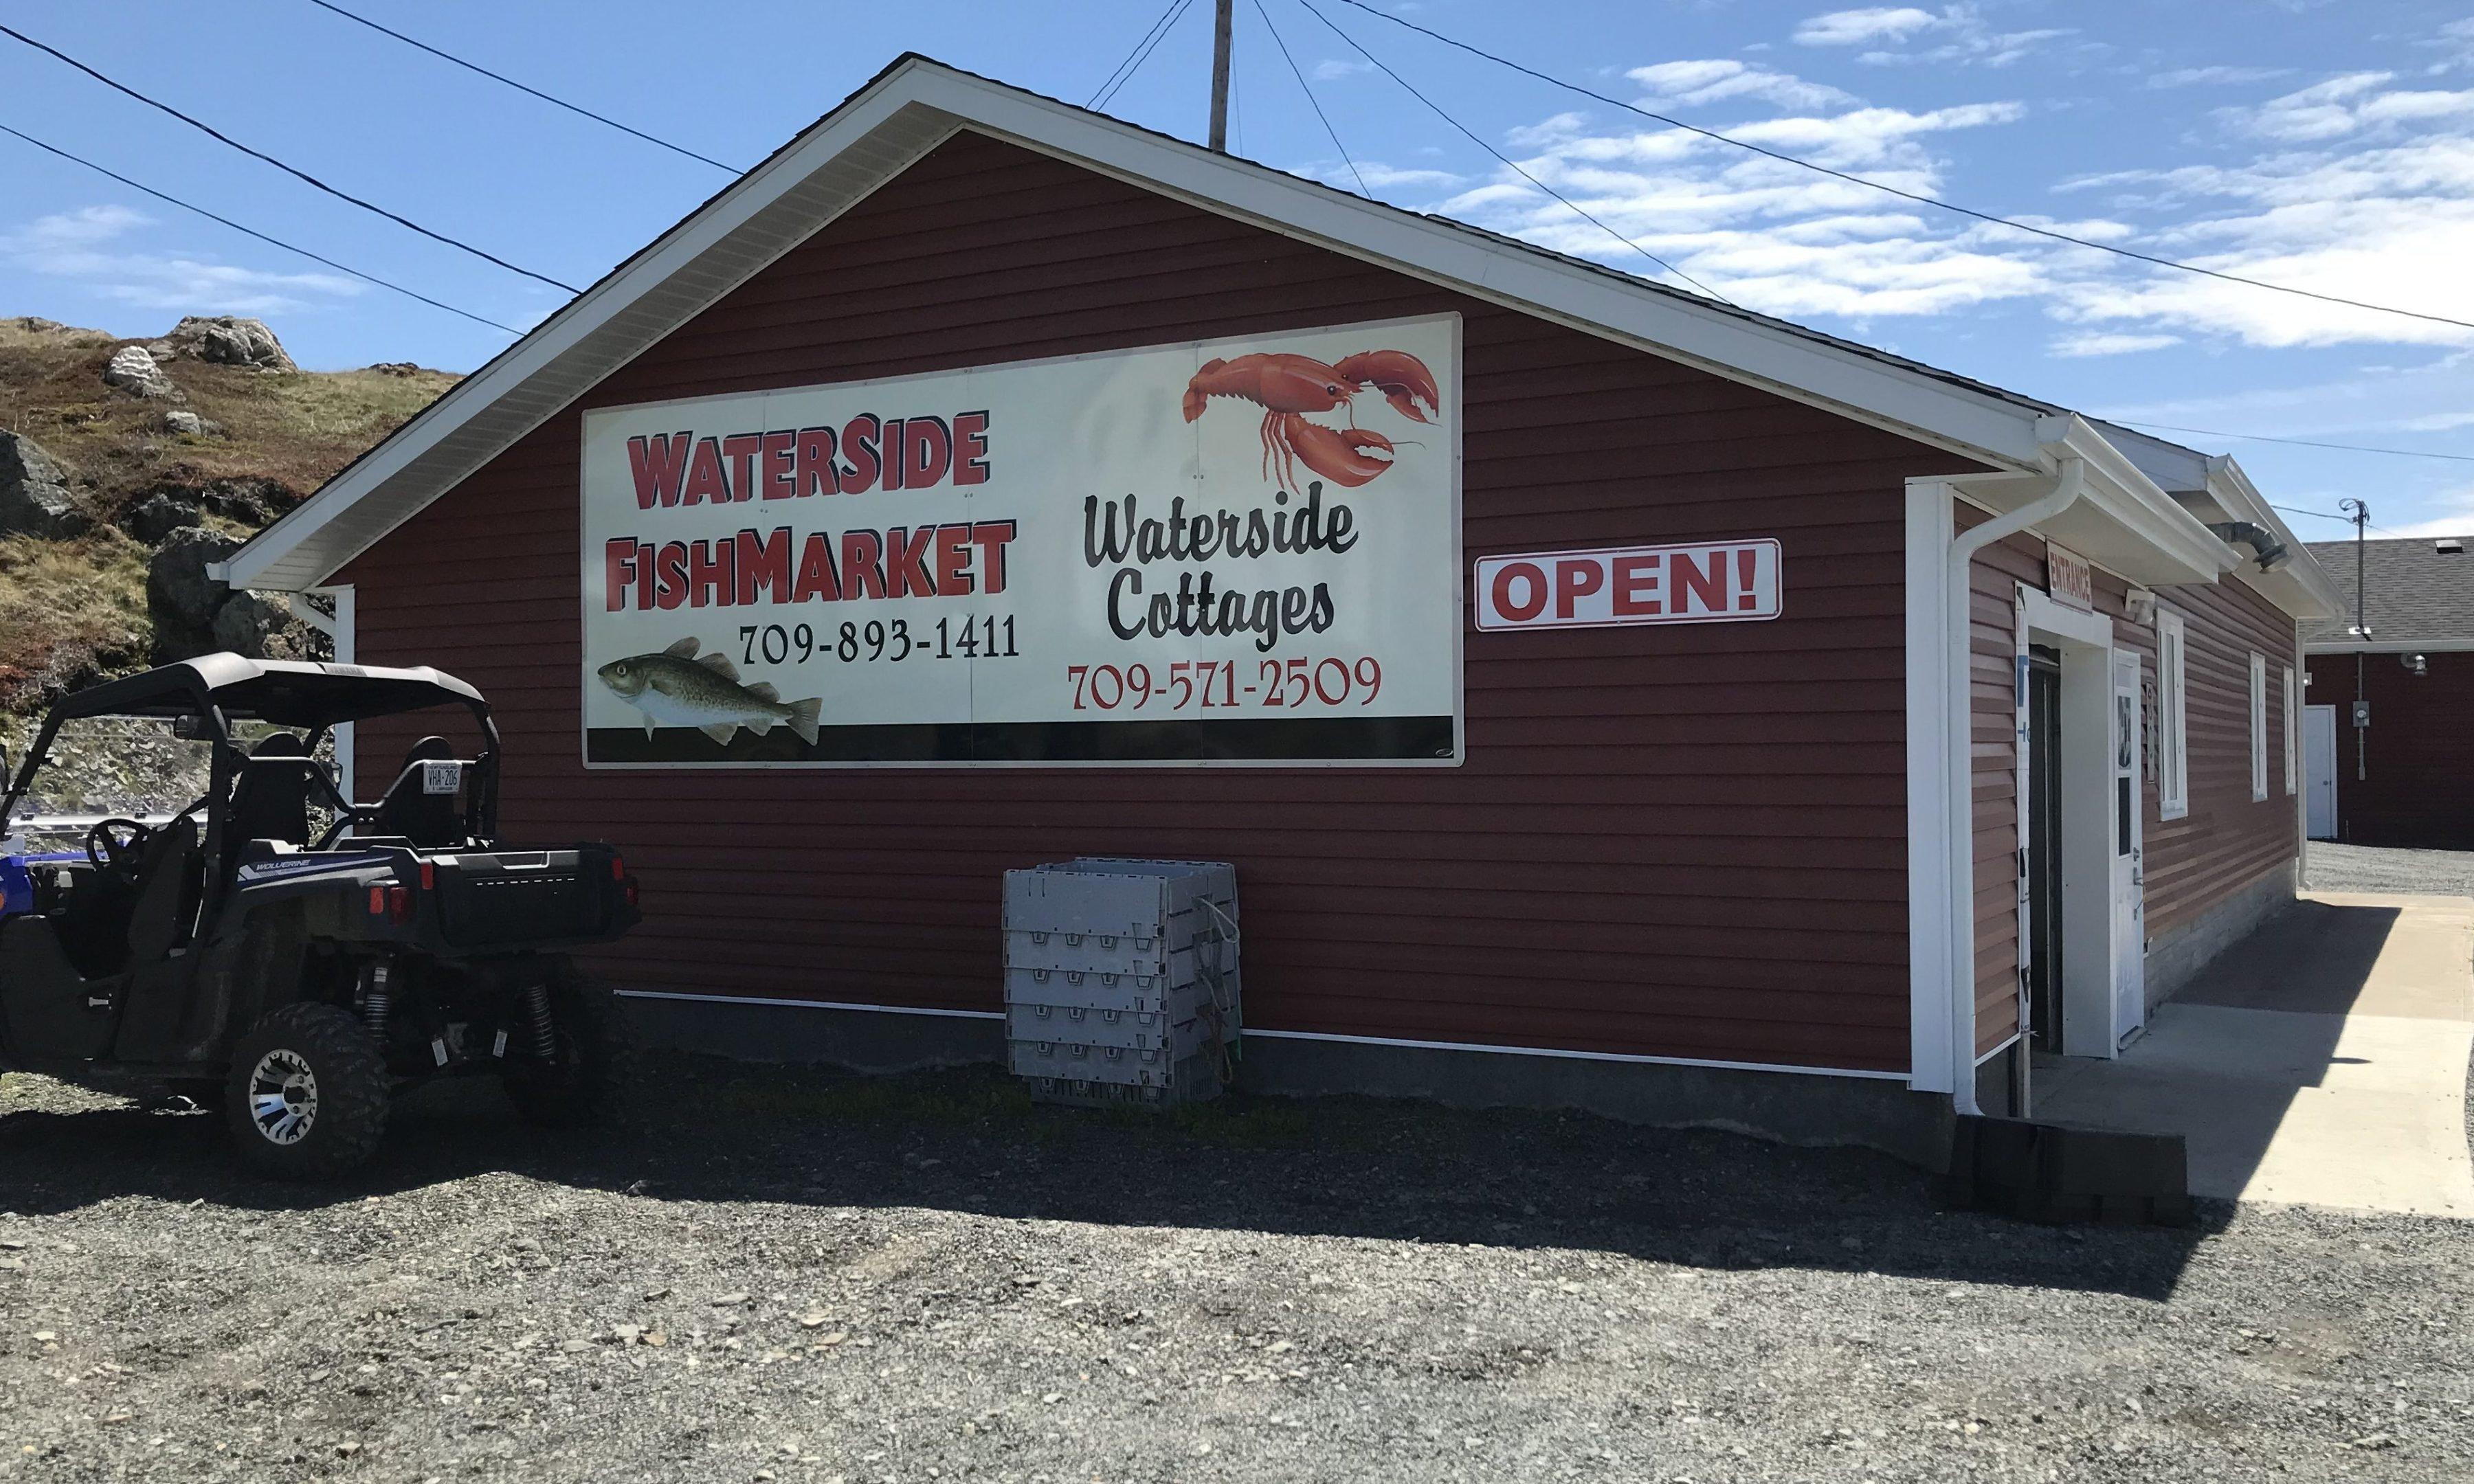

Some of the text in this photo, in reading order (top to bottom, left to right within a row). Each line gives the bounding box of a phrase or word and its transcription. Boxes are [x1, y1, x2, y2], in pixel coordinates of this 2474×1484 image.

[1084, 481, 1359, 567] Waterside
[1492, 550, 1756, 621] OPEN!
[2050, 552, 2091, 603] ENTRANCE
[739, 614, 1019, 665] 709-893-1411
[1107, 567, 1334, 652] Cottages
[1068, 656, 1381, 710] 709-571-2509
